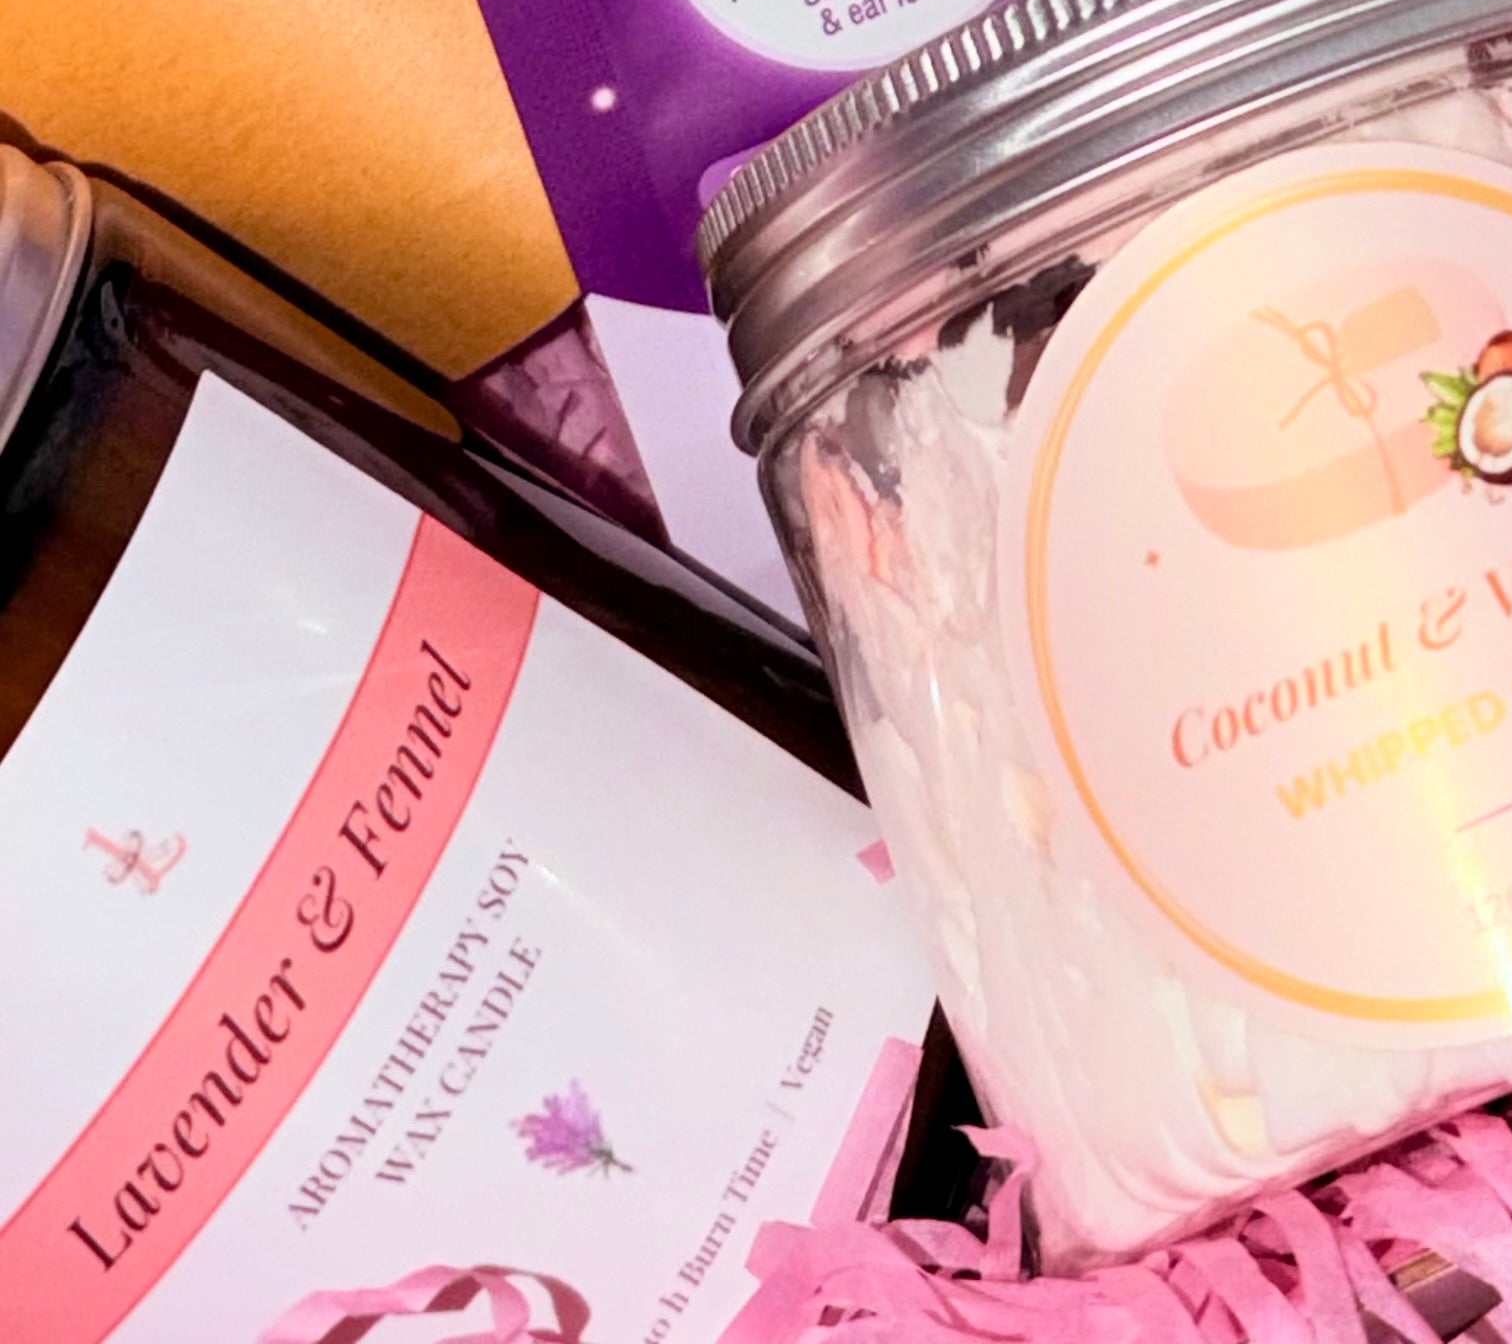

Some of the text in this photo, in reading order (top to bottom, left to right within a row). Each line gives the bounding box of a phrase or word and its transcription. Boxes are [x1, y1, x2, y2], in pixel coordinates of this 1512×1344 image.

[820, 8, 843, 38] &
[1171, 620, 1398, 768] Coconut
[1418, 585, 1470, 654] &
[1274, 687, 1507, 821] WHIPPED
[66, 641, 473, 1272] Lavender & Fennel
[287, 837, 530, 1232] AROMATHERAPY SOY
[375, 936, 543, 1184] WAX CANDLE
[659, 1290, 690, 1315] h
[677, 1214, 736, 1287] Burn
[722, 1128, 778, 1204] Time
[780, 1005, 834, 1089] Vegan
